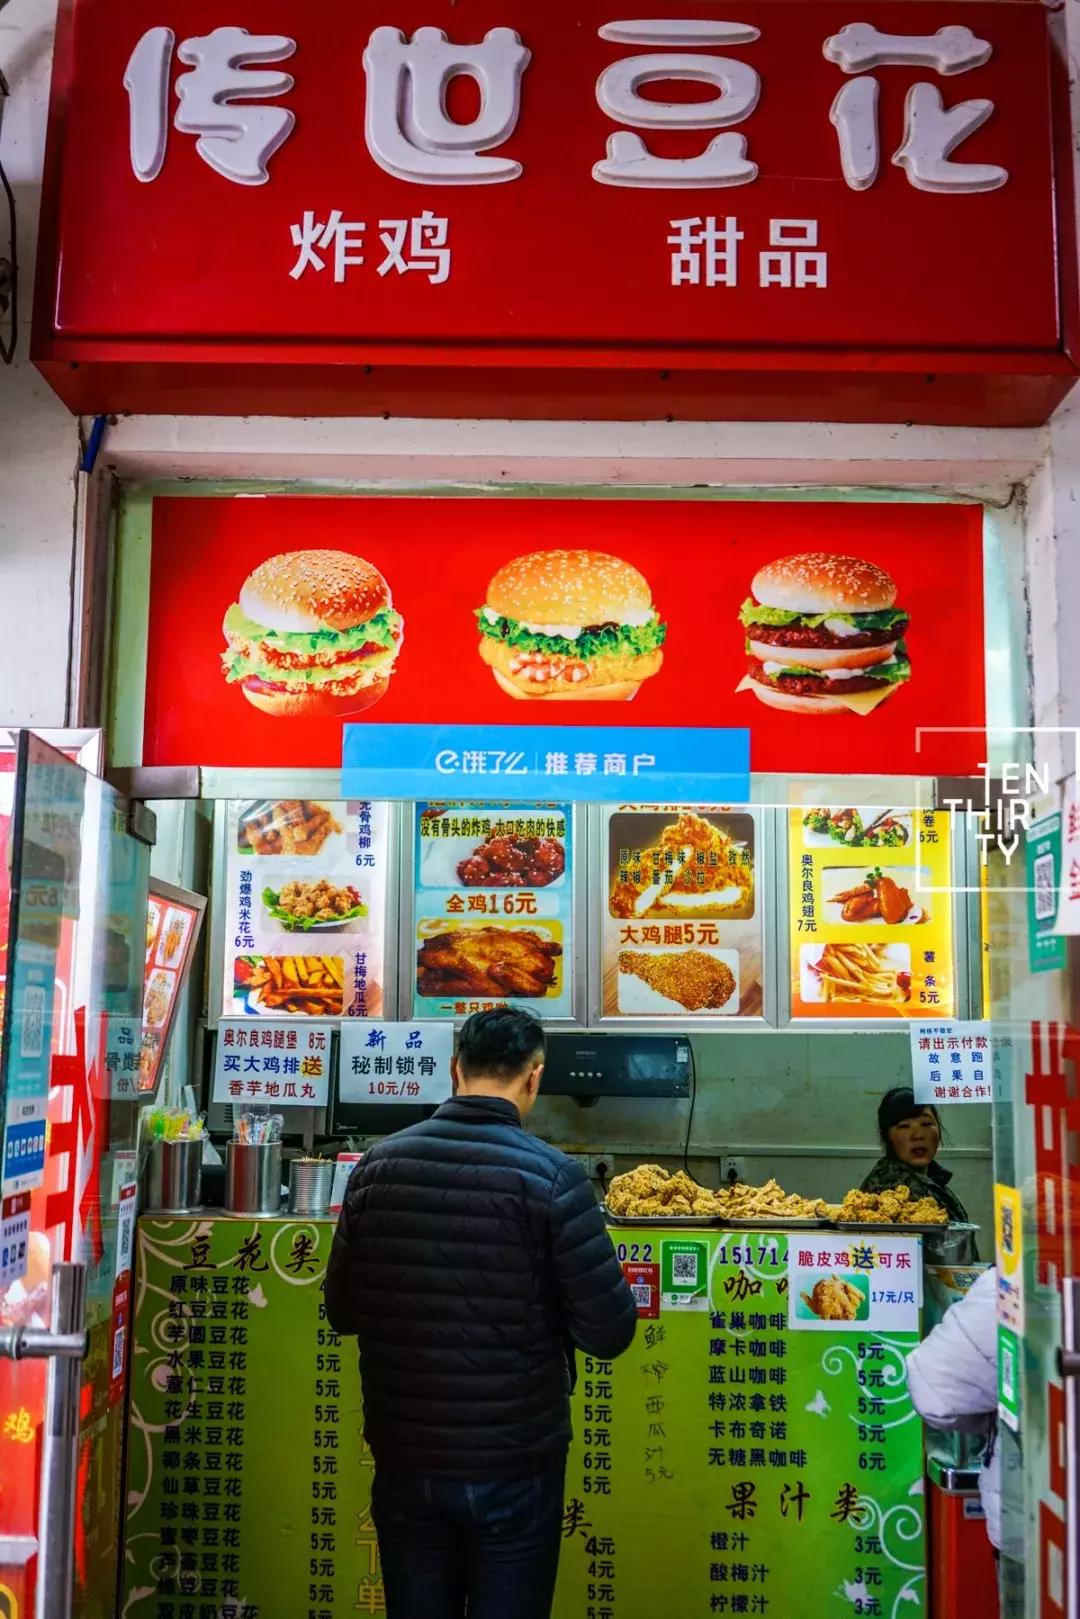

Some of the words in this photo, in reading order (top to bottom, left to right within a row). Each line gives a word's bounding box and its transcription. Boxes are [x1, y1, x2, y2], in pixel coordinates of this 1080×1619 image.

[123, 23, 1009, 194] 传世豆花
[288, 211, 451, 283] 炸鸡
[668, 216, 829, 288] 甜品
[545, 752, 656, 777] 推荐商户
[421, 818, 492, 837] 没有骨头的炸鸡
[356, 854, 376, 867] 6元
[801, 854, 814, 918] 奥尔良鸡翅
[239, 870, 252, 934] 劲爆鸡米花
[446, 892, 537, 914] 全鸡16元
[620, 923, 719, 945] 大鸡腿5元
[797, 920, 817, 932] 7元
[235, 936, 255, 948] 6元
[354, 952, 367, 1003] 甘梅地瓜
[924, 950, 935, 987] 薯条
[920, 991, 940, 1004] 5元
[223, 1028, 298, 1049] 奥尔良鸡腿堡
[308, 1032, 326, 1050] 8元
[364, 1029, 424, 1050] 新品
[918, 1036, 989, 1050] 请出示付款
[223, 1055, 323, 1076] 买大鸡排送
[351, 1056, 437, 1075] 秘制锁骨
[928, 1052, 984, 1064] 故意跑
[930, 1070, 984, 1082] 后果自
[228, 1080, 316, 1098] 香芋地瓜丸
[368, 1081, 421, 1096] 10元/份
[182, 1232, 320, 1273] 豆花类
[799, 1247, 911, 1269] 脆皮鸡送可乐
[170, 1275, 250, 1295] 原味豆花
[872, 1291, 914, 1304] 17元/只
[169, 1301, 249, 1320] 红豆豆花
[709, 1312, 787, 1330] 雀巢咖啡
[317, 1330, 342, 1347] 5元
[709, 1339, 787, 1357] 摩卡咖啡
[857, 1342, 885, 1360] 5元
[167, 1351, 246, 1370] 水果豆花
[316, 1354, 341, 1372] 5元
[708, 1366, 787, 1385] 蓝山咖啡
[858, 1370, 885, 1388] 5元
[316, 1379, 340, 1397] 5元
[584, 1381, 612, 1399] 5元
[165, 1401, 245, 1421] 花生豆花
[315, 1405, 340, 1423] 5元
[584, 1404, 612, 1423] 5元
[708, 1393, 787, 1412] 特浓拿铁
[858, 1397, 885, 1415] 5元
[163, 1426, 245, 1446] 黑米豆花
[314, 1430, 339, 1448] 5元
[584, 1429, 611, 1447] 5元
[708, 1420, 787, 1440] 卡布奇诺
[858, 1425, 886, 1444] 5元
[313, 1455, 338, 1475] 5元
[584, 1452, 611, 1471] 6元
[708, 1448, 808, 1467] 无糖黑咖啡
[859, 1452, 886, 1471] 6元
[161, 1477, 242, 1497] 仙草豆花
[312, 1481, 337, 1500] 5元
[583, 1476, 611, 1495] 5元
[725, 1481, 867, 1524] 果汁类
[160, 1502, 241, 1522] 珍珠豆花
[311, 1507, 336, 1526] 5元
[310, 1532, 336, 1551] 5元
[710, 1531, 749, 1551] 橙汁
[854, 1536, 882, 1555] 3元
[309, 1558, 335, 1577] 5元
[588, 1561, 615, 1579] 4元
[710, 1563, 769, 1583] 酸梅汁
[854, 1567, 882, 1586] 3元
[309, 1584, 334, 1602] 5元
[587, 1584, 615, 1602] 5元
[710, 1594, 769, 1614] 柠檬汁
[854, 1598, 882, 1617] 3元
